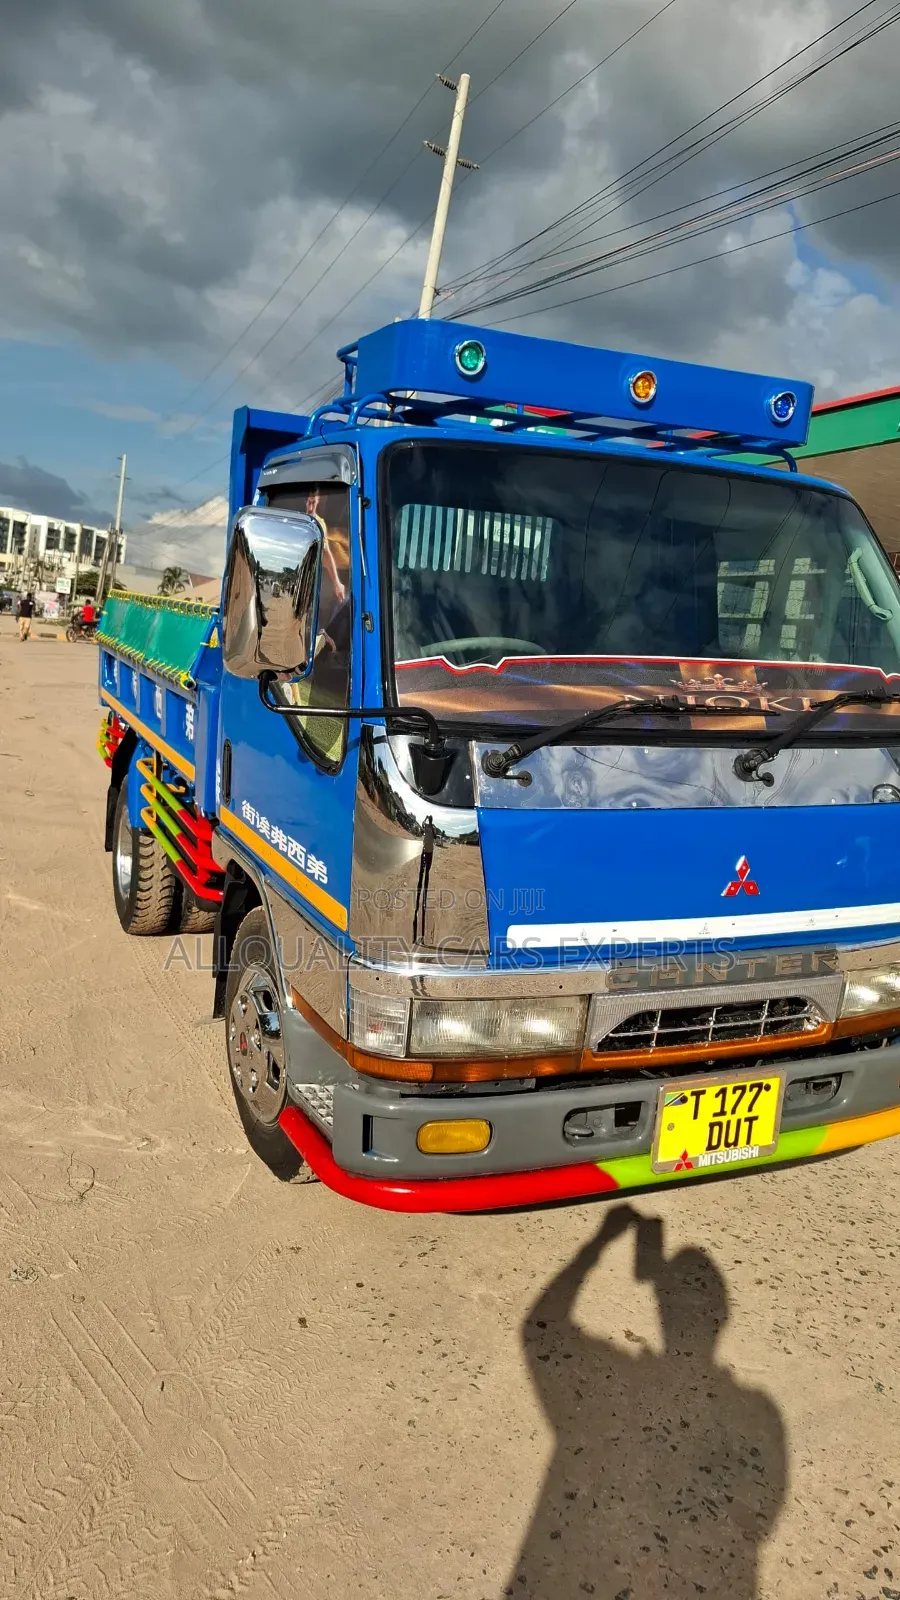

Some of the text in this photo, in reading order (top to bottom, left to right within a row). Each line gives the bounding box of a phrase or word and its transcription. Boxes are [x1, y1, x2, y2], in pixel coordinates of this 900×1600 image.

[605, 951, 840, 990] CANTER
[690, 1082, 764, 1121] T 177
[705, 1115, 759, 1152] DUT
[698, 1145, 759, 1167] MITSUBISHI
